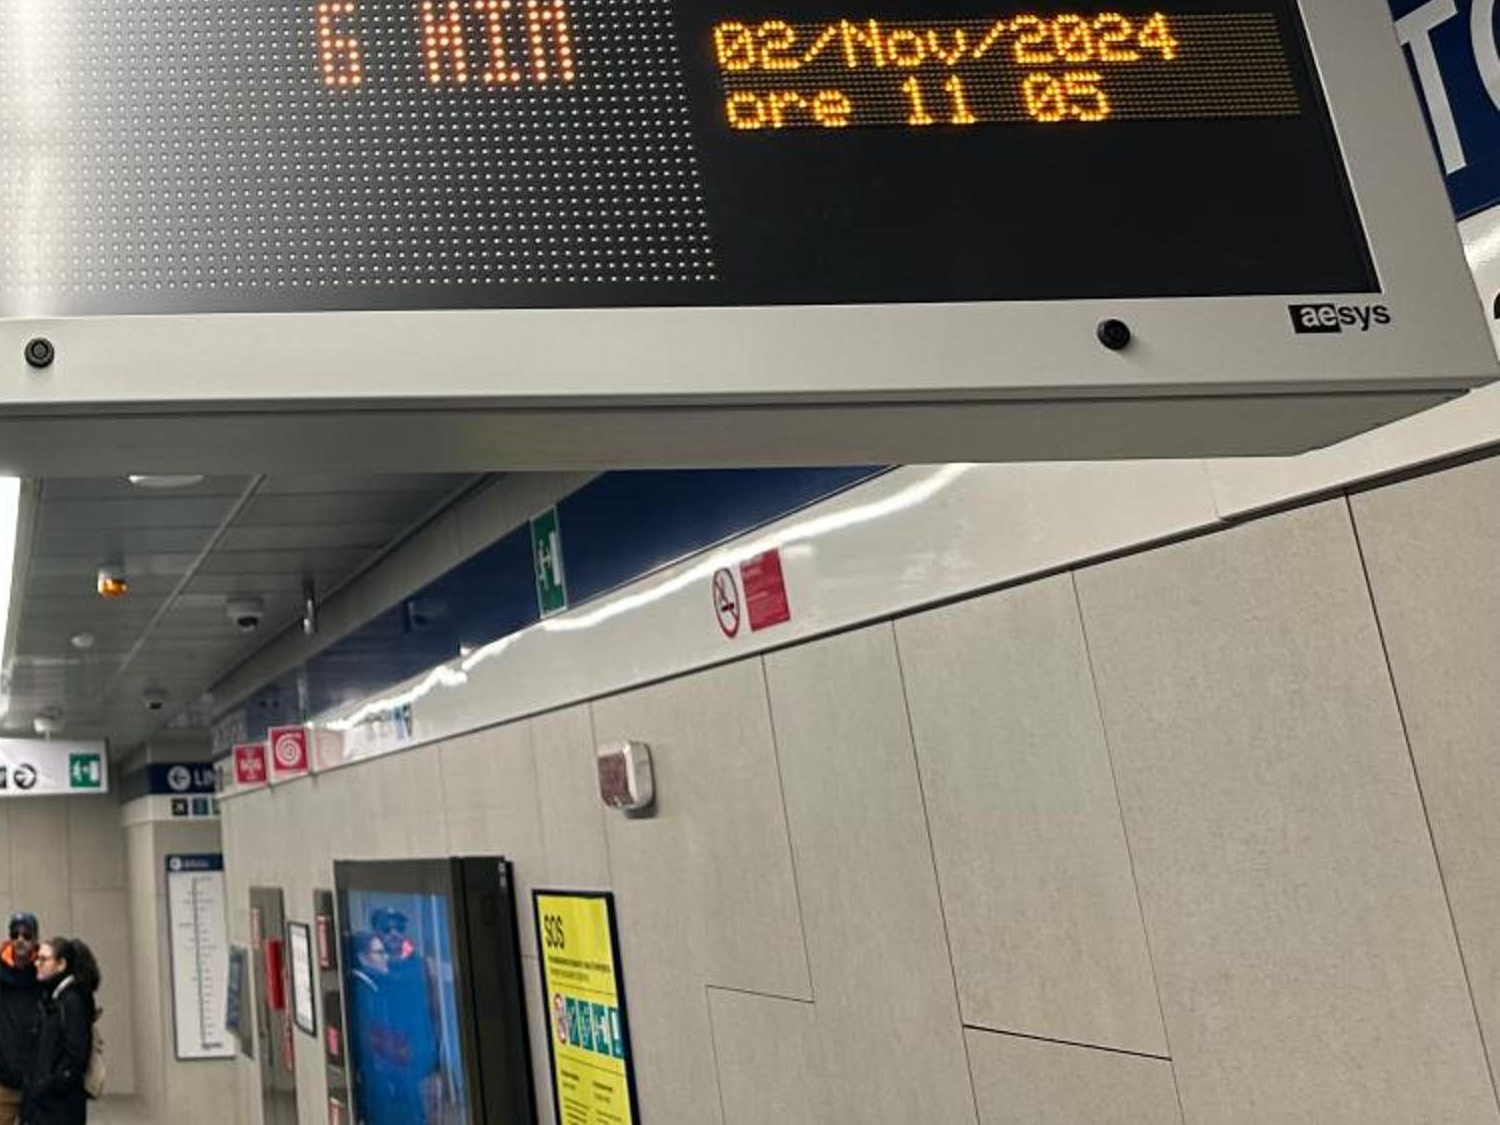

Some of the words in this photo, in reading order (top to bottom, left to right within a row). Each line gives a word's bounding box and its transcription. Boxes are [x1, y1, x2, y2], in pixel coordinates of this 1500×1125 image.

[318, 2, 361, 87] 6
[713, 12, 1180, 71] 02/Nov/2024
[725, 89, 852, 130] ore
[901, 74, 976, 125] 11
[1022, 70, 1111, 123] 05
[1299, 304, 1392, 332] aesys
[543, 914, 565, 950] SOS
